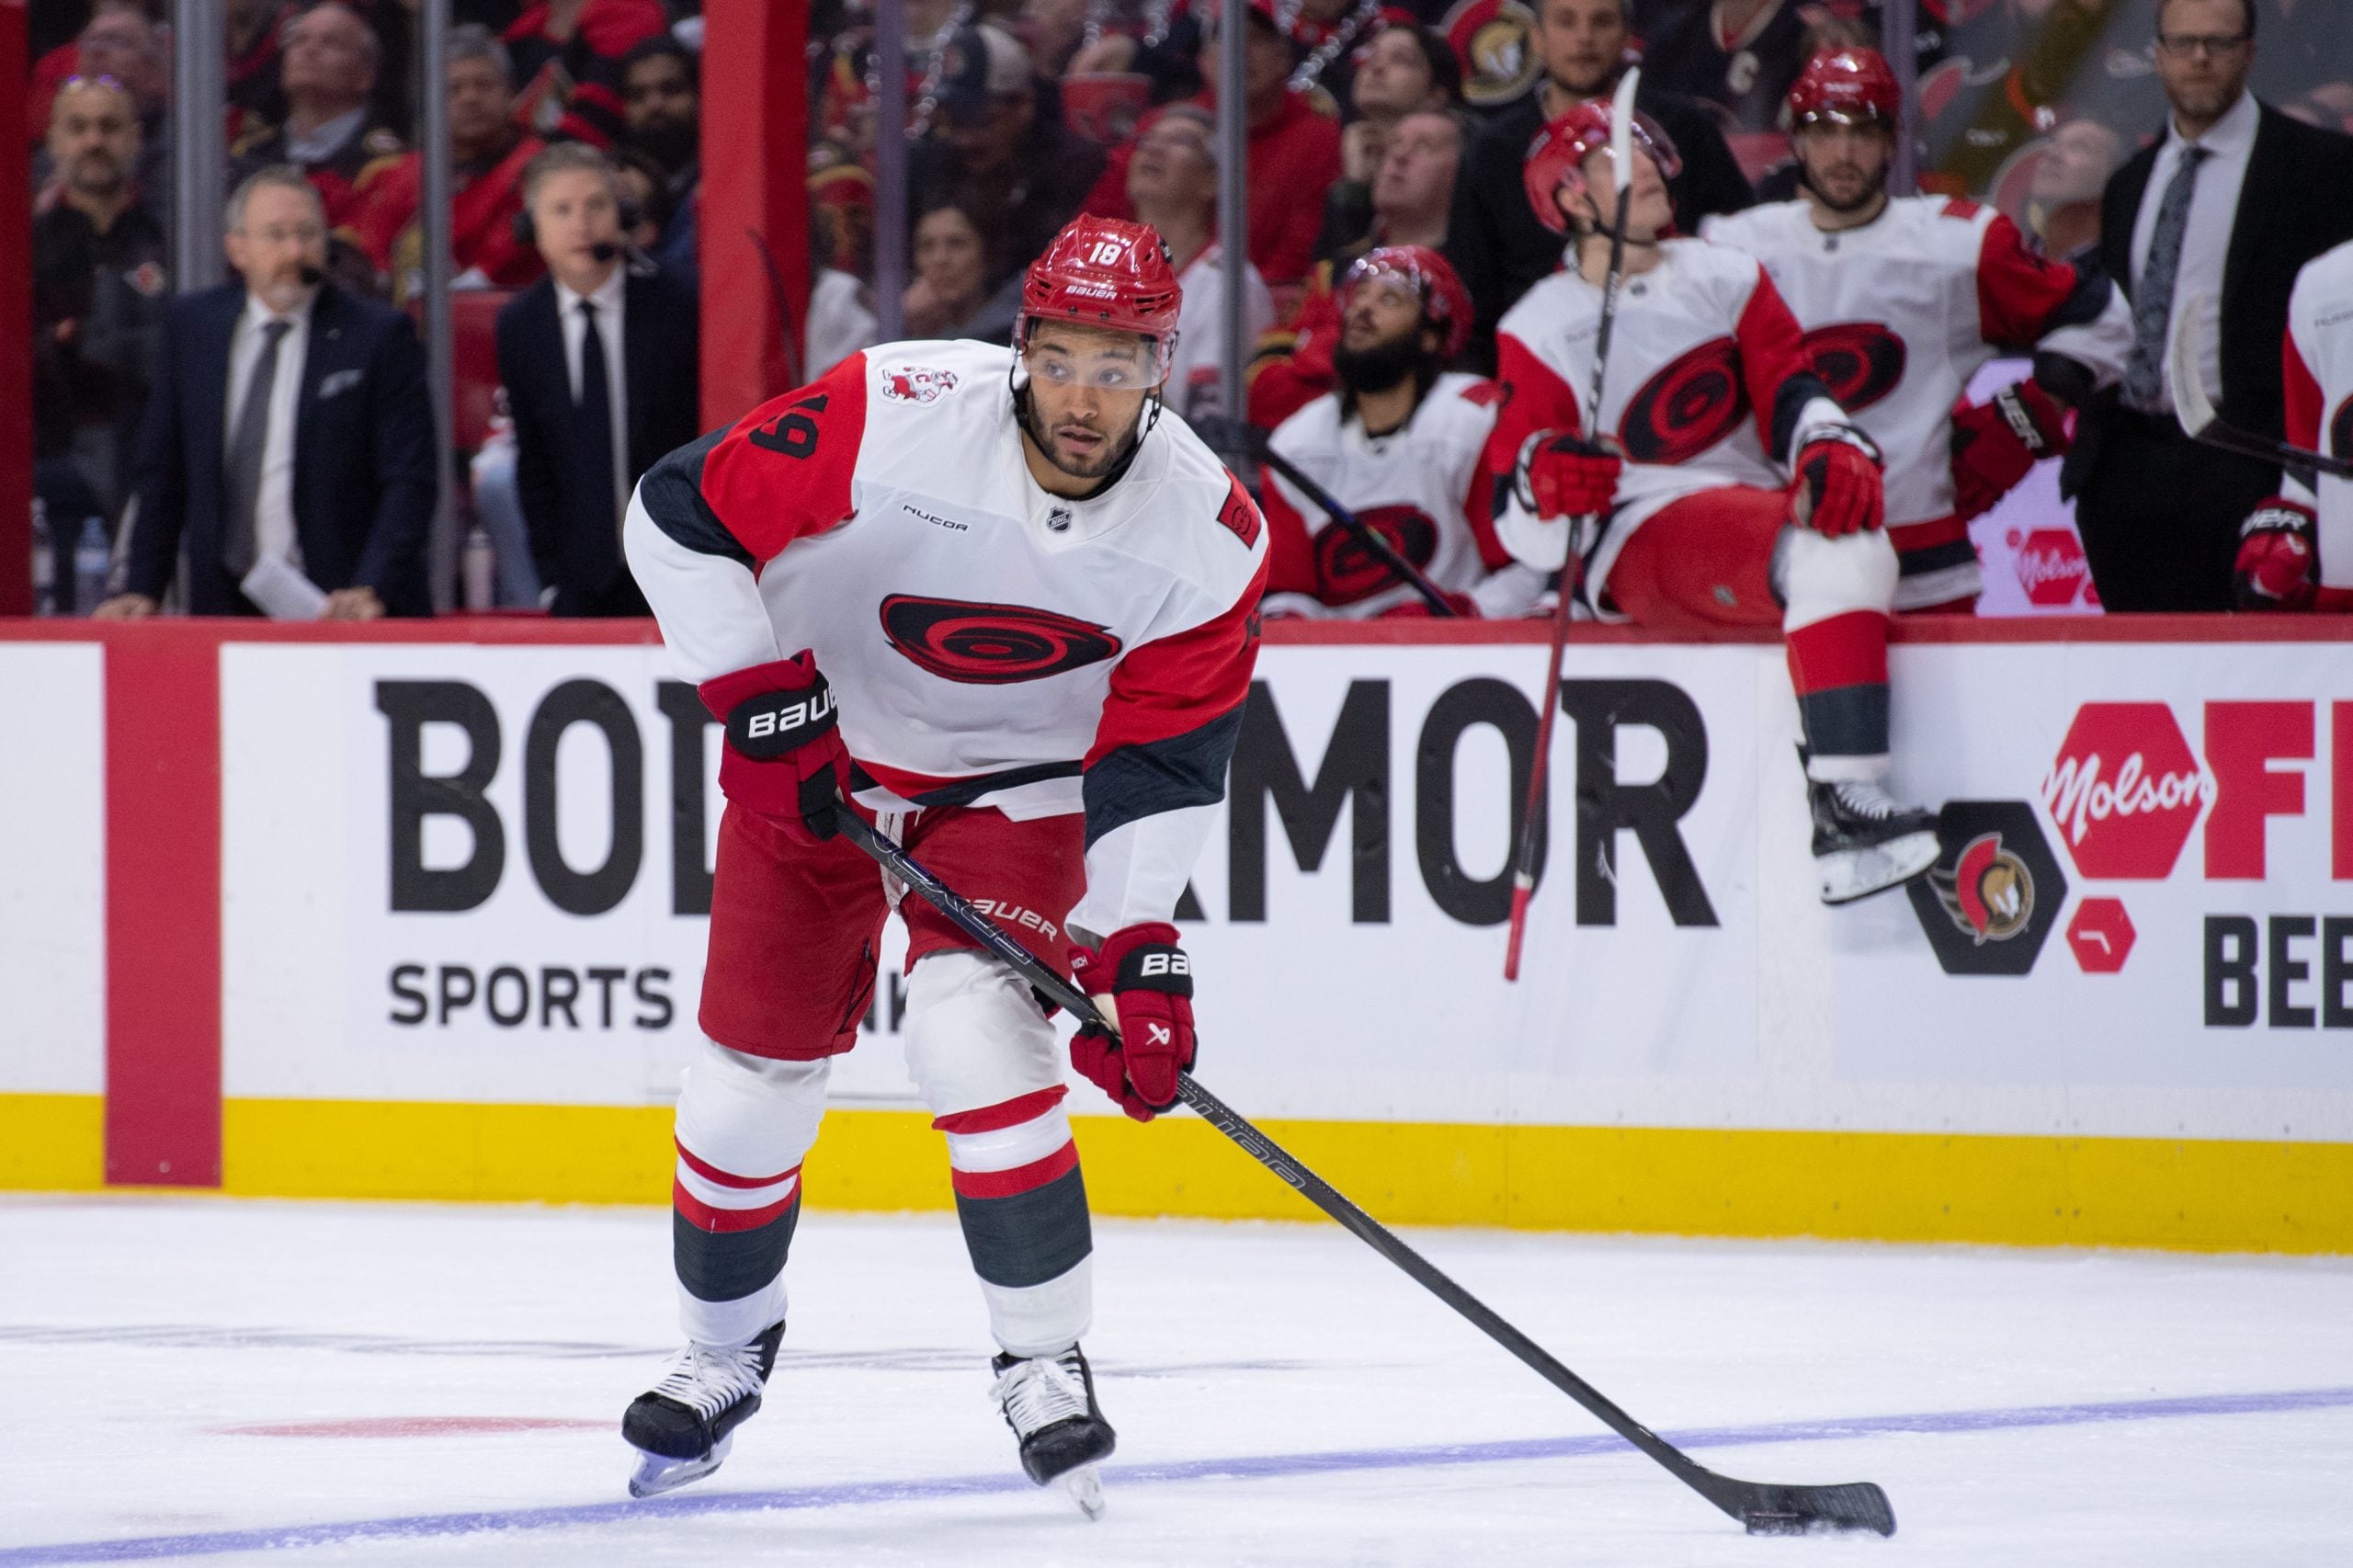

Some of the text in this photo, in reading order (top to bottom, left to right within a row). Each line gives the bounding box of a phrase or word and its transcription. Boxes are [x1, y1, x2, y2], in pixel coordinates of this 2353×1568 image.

[1066, 285, 1117, 300] BAUER
[903, 505, 969, 532] NUCOR
[748, 687, 837, 738] BAU
[2044, 752, 2210, 846] Molson
[964, 898, 1058, 942] AUER
[390, 964, 675, 1030] SPORTS
